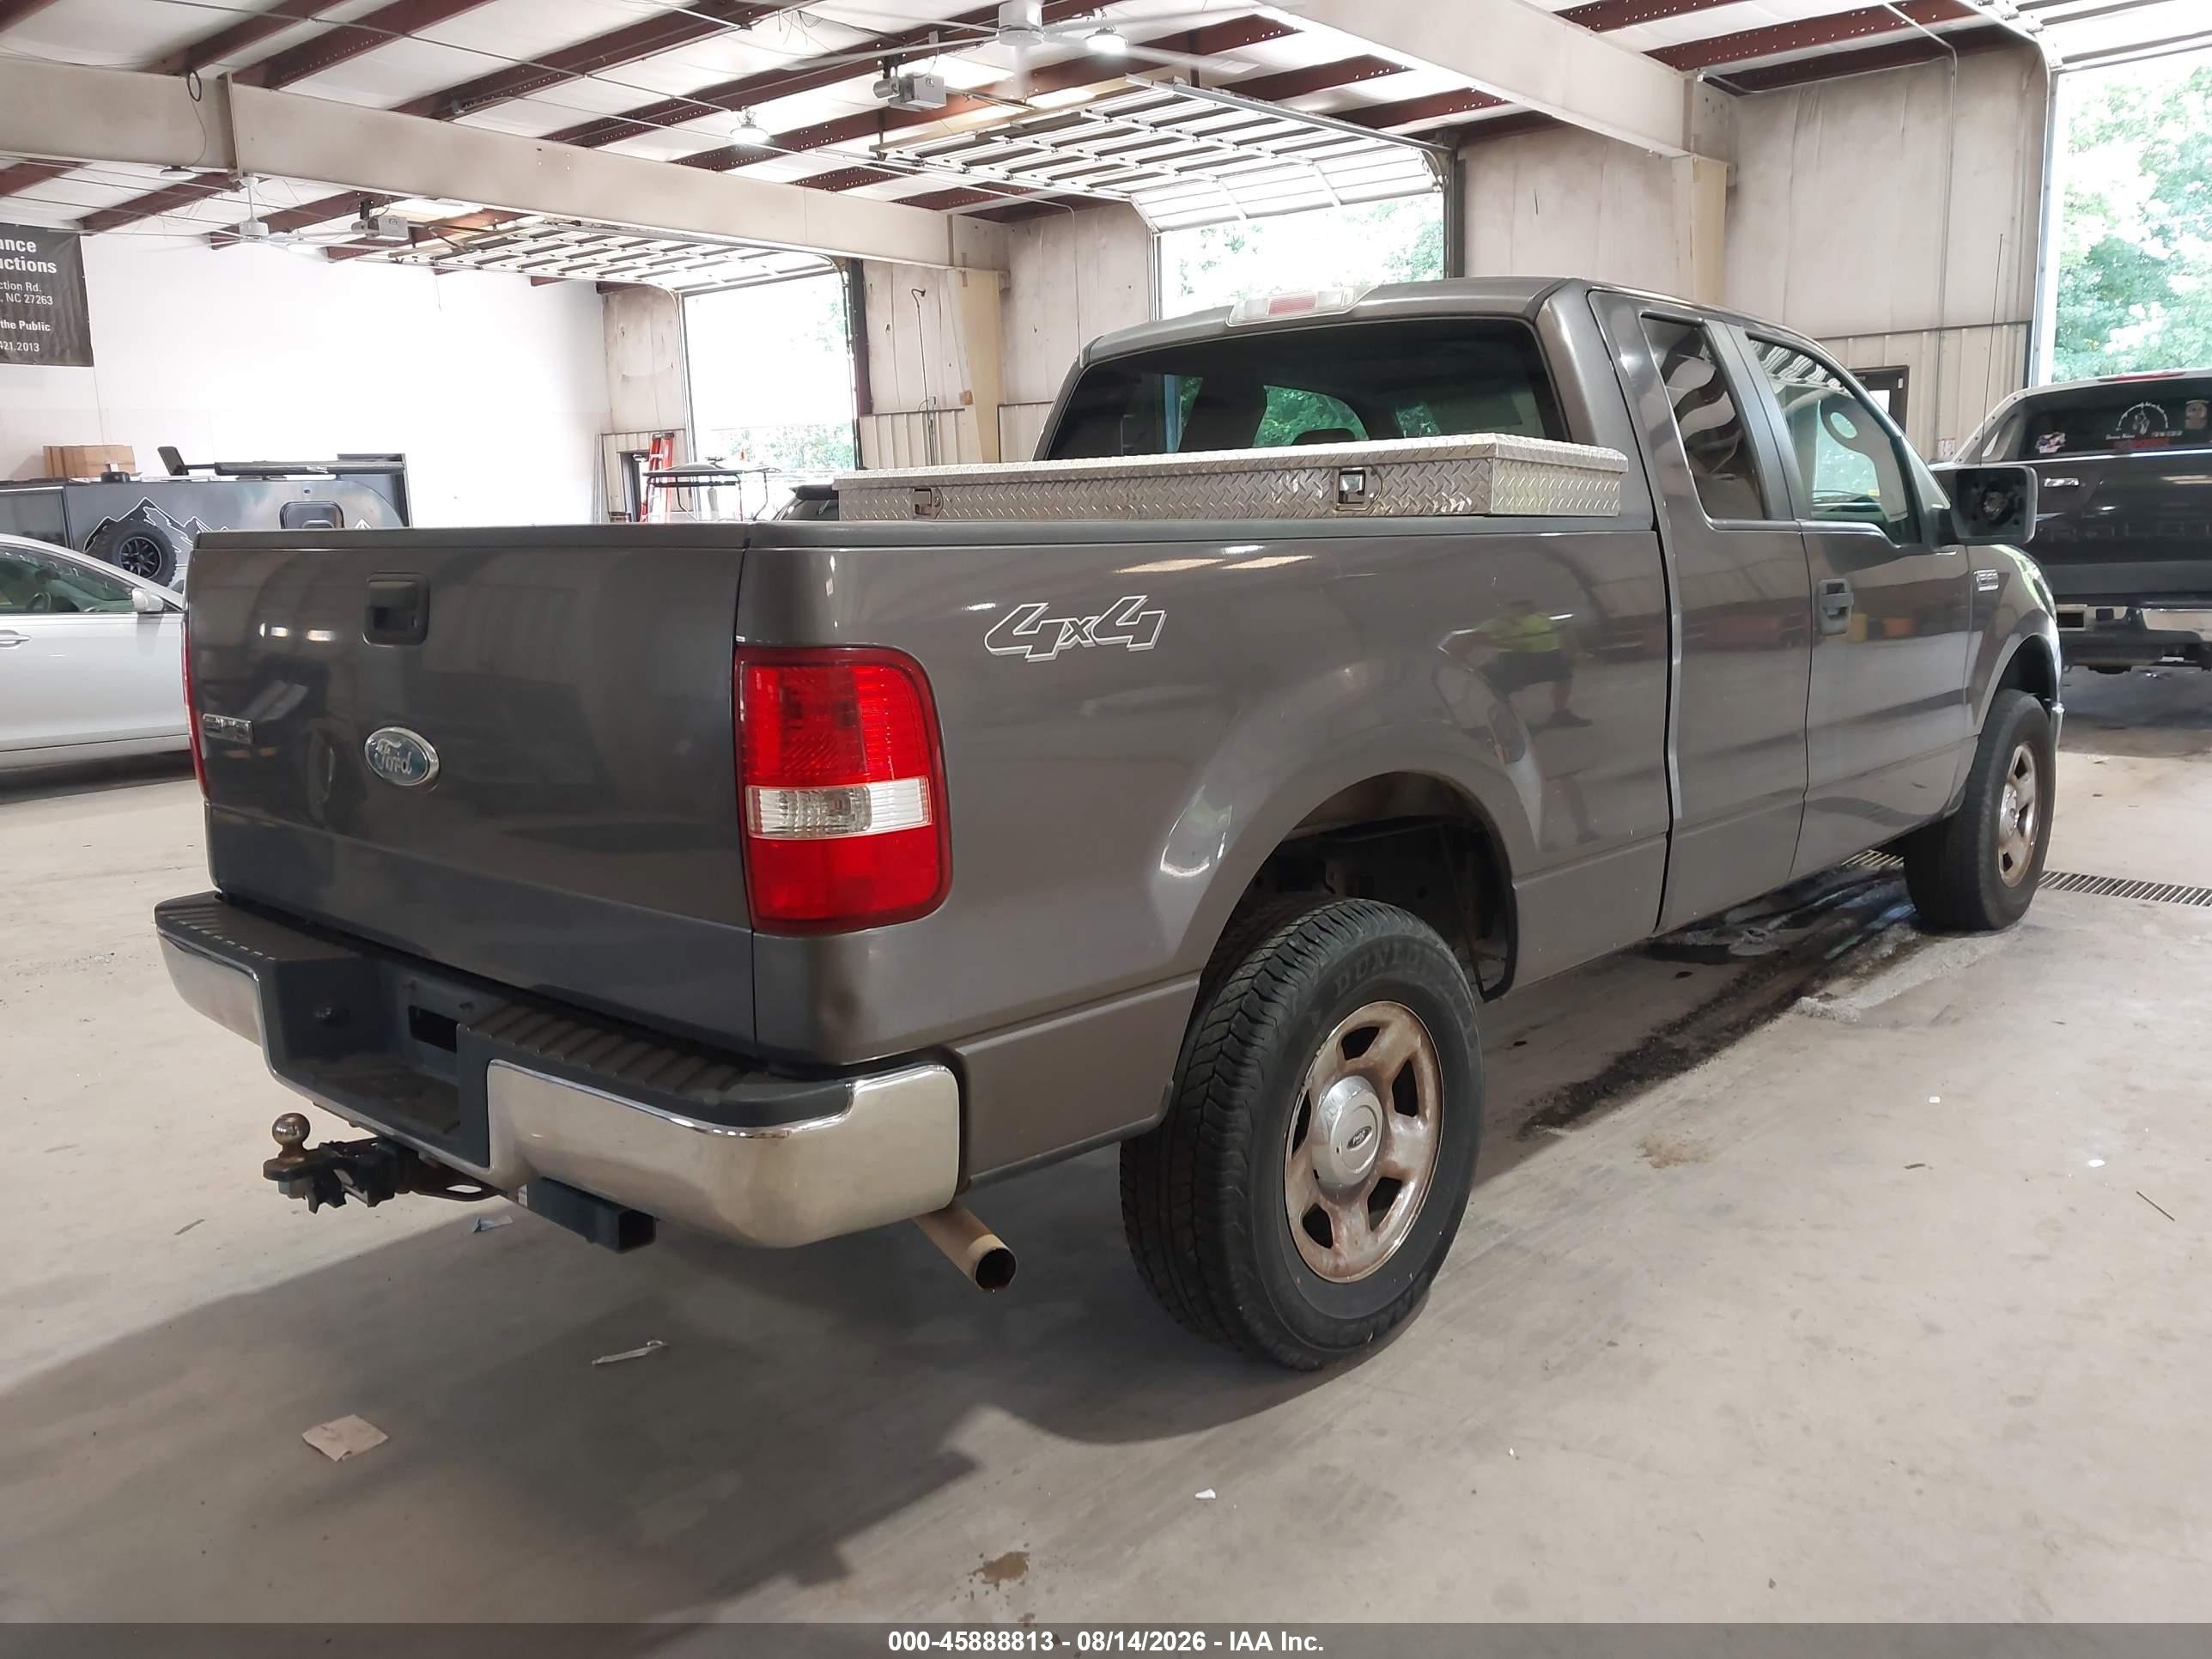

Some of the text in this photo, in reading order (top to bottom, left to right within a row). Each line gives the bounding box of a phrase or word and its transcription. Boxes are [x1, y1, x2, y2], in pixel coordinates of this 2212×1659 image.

[25, 282, 42, 292] Rd.
[5, 292, 53, 305] NC 27263
[0, 319, 52, 331] the Public
[984, 594, 1168, 662] 4x4
[374, 738, 413, 775] Ford
